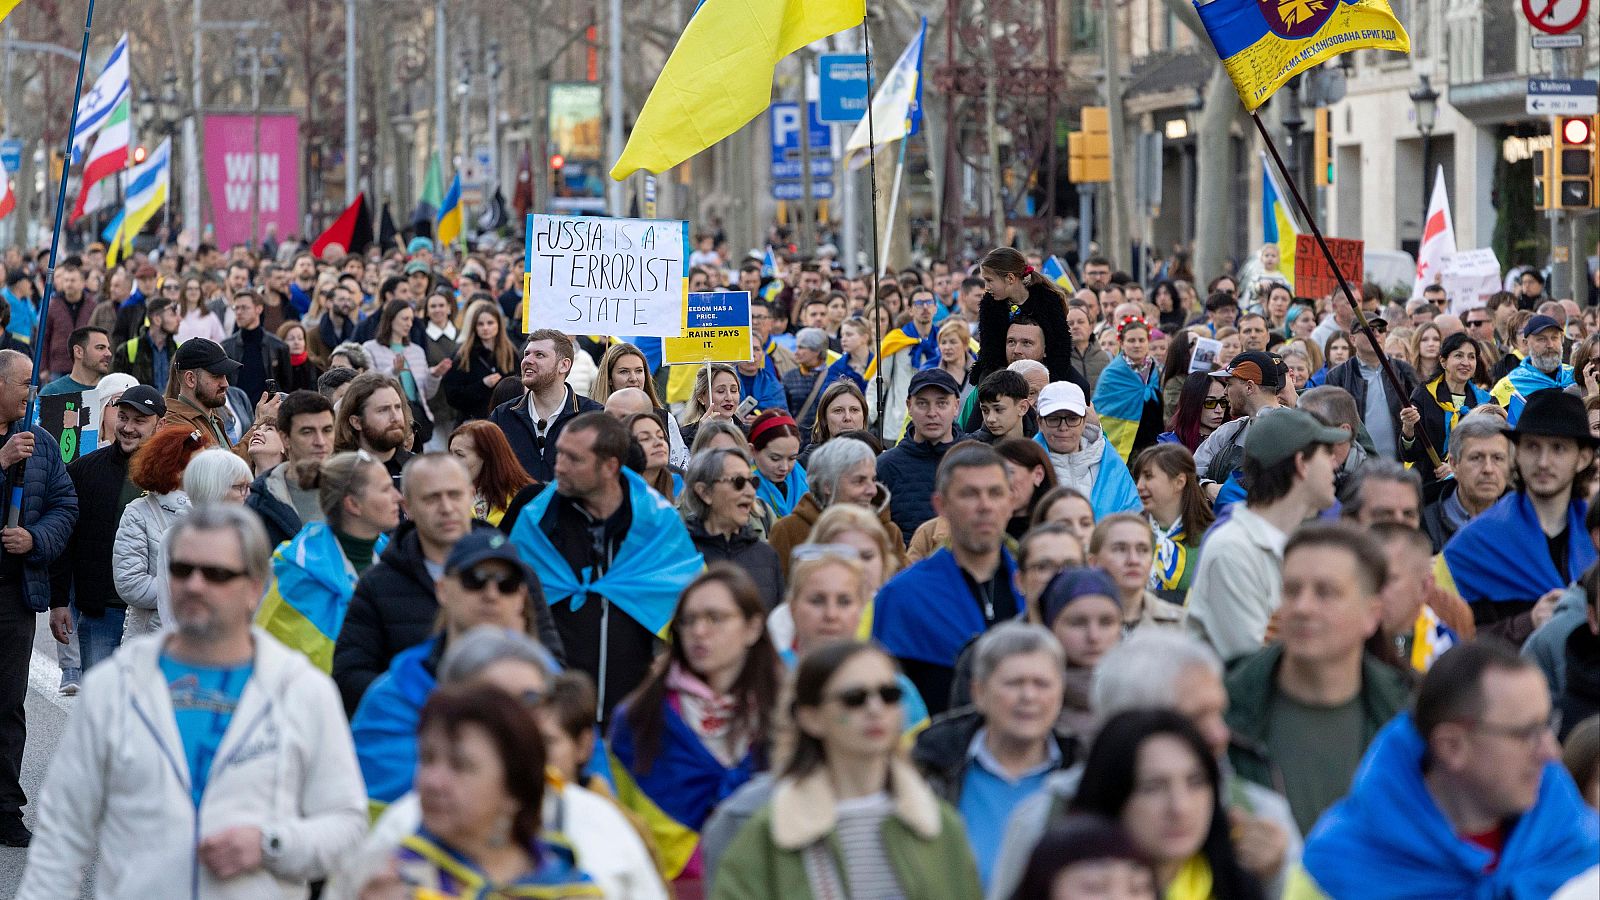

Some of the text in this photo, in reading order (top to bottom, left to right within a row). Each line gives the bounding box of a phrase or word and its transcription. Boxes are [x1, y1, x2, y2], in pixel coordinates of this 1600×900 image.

[1299, 31, 1361, 61] МЕХАНІЗОВАНА
[1362, 29, 1396, 41] БРИГАДА
[773, 106, 800, 147] P
[224, 183, 279, 212] WN
[615, 224, 633, 250] IS
[644, 225, 655, 250] A
[1326, 263, 1363, 281] CSA
[565, 294, 651, 326] STATE
[687, 330, 716, 338] RAINE
[64, 433, 72, 455] $
